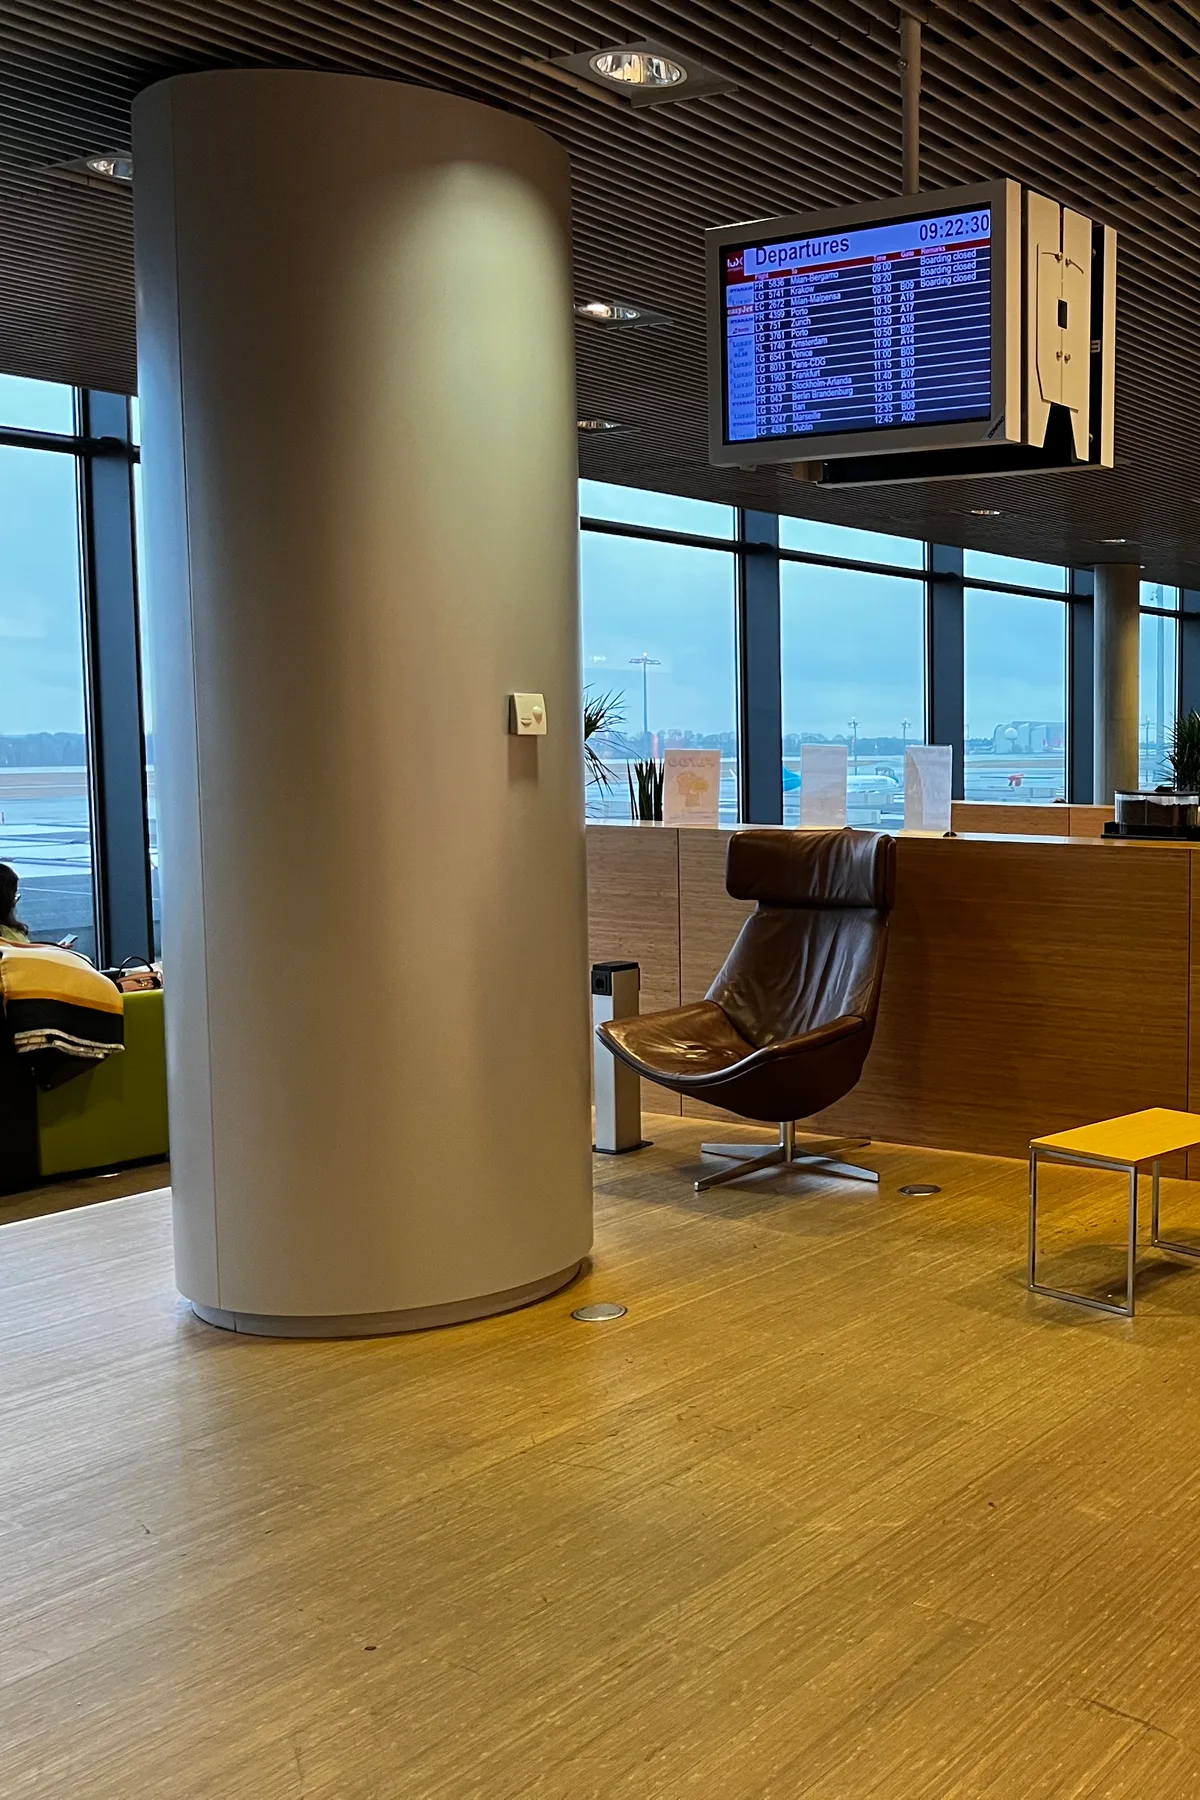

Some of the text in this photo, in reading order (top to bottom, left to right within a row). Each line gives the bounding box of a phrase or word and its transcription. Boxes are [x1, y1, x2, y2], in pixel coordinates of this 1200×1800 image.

[920, 214, 990, 241] 09:22:30
[756, 236, 849, 266] Departures
[901, 250, 915, 258] Gate
[920, 246, 946, 255] Remarks
[755, 282, 765, 290] FR
[790, 272, 839, 285] Milan-Bergamo
[872, 262, 892, 273] 09:00
[920, 254, 951, 266] Boarding
[953, 249, 977, 260] closed
[755, 261, 977, 301] LG 5741 Krakow 09:20 Boarding closed
[755, 302, 765, 311] EC
[790, 293, 841, 306] Milan-Malpensa
[872, 285, 892, 294] 09:30
[900, 282, 915, 291] B09
[920, 276, 952, 288] Boarding
[953, 272, 977, 283] closed
[755, 292, 915, 322] FR 4399 Porto 10:10 A19
[755, 323, 764, 332] LX
[770, 321, 781, 330] 751
[873, 306, 892, 316] 10:35
[900, 304, 915, 313] A17
[755, 334, 765, 343] LG
[791, 329, 809, 338] Porto
[874, 317, 892, 327] 10:50
[900, 315, 915, 324] A16
[756, 325, 915, 353] KL 1740 Amsterdam 10:50 B02
[756, 336, 915, 363] LG 6541 Venice 11:00 A14
[756, 364, 766, 374] LG
[792, 358, 826, 369] Paris-CDG
[874, 350, 892, 359] 11:00
[901, 347, 915, 357] B03
[756, 375, 766, 384] LG
[792, 369, 821, 380] Frankfurt
[874, 360, 892, 370] 11:15
[901, 358, 915, 368] B10
[756, 369, 915, 394] LG 5783 Stockholm-Arlanda 11:40 B07
[756, 395, 766, 404] FR
[792, 392, 811, 401] Berlin
[812, 388, 854, 399] Brandenburg
[874, 382, 893, 391] 12:15
[901, 380, 916, 389] A19
[757, 391, 915, 415] LG 537 Bari 12:20 B04
[757, 416, 766, 425] FR
[793, 412, 821, 422] Marseille
[874, 403, 893, 413] 12:35
[902, 402, 916, 411] B09
[758, 426, 767, 436] LG
[793, 423, 814, 432] Dublin
[875, 414, 893, 424] 12:45
[901, 413, 916, 422] A02
